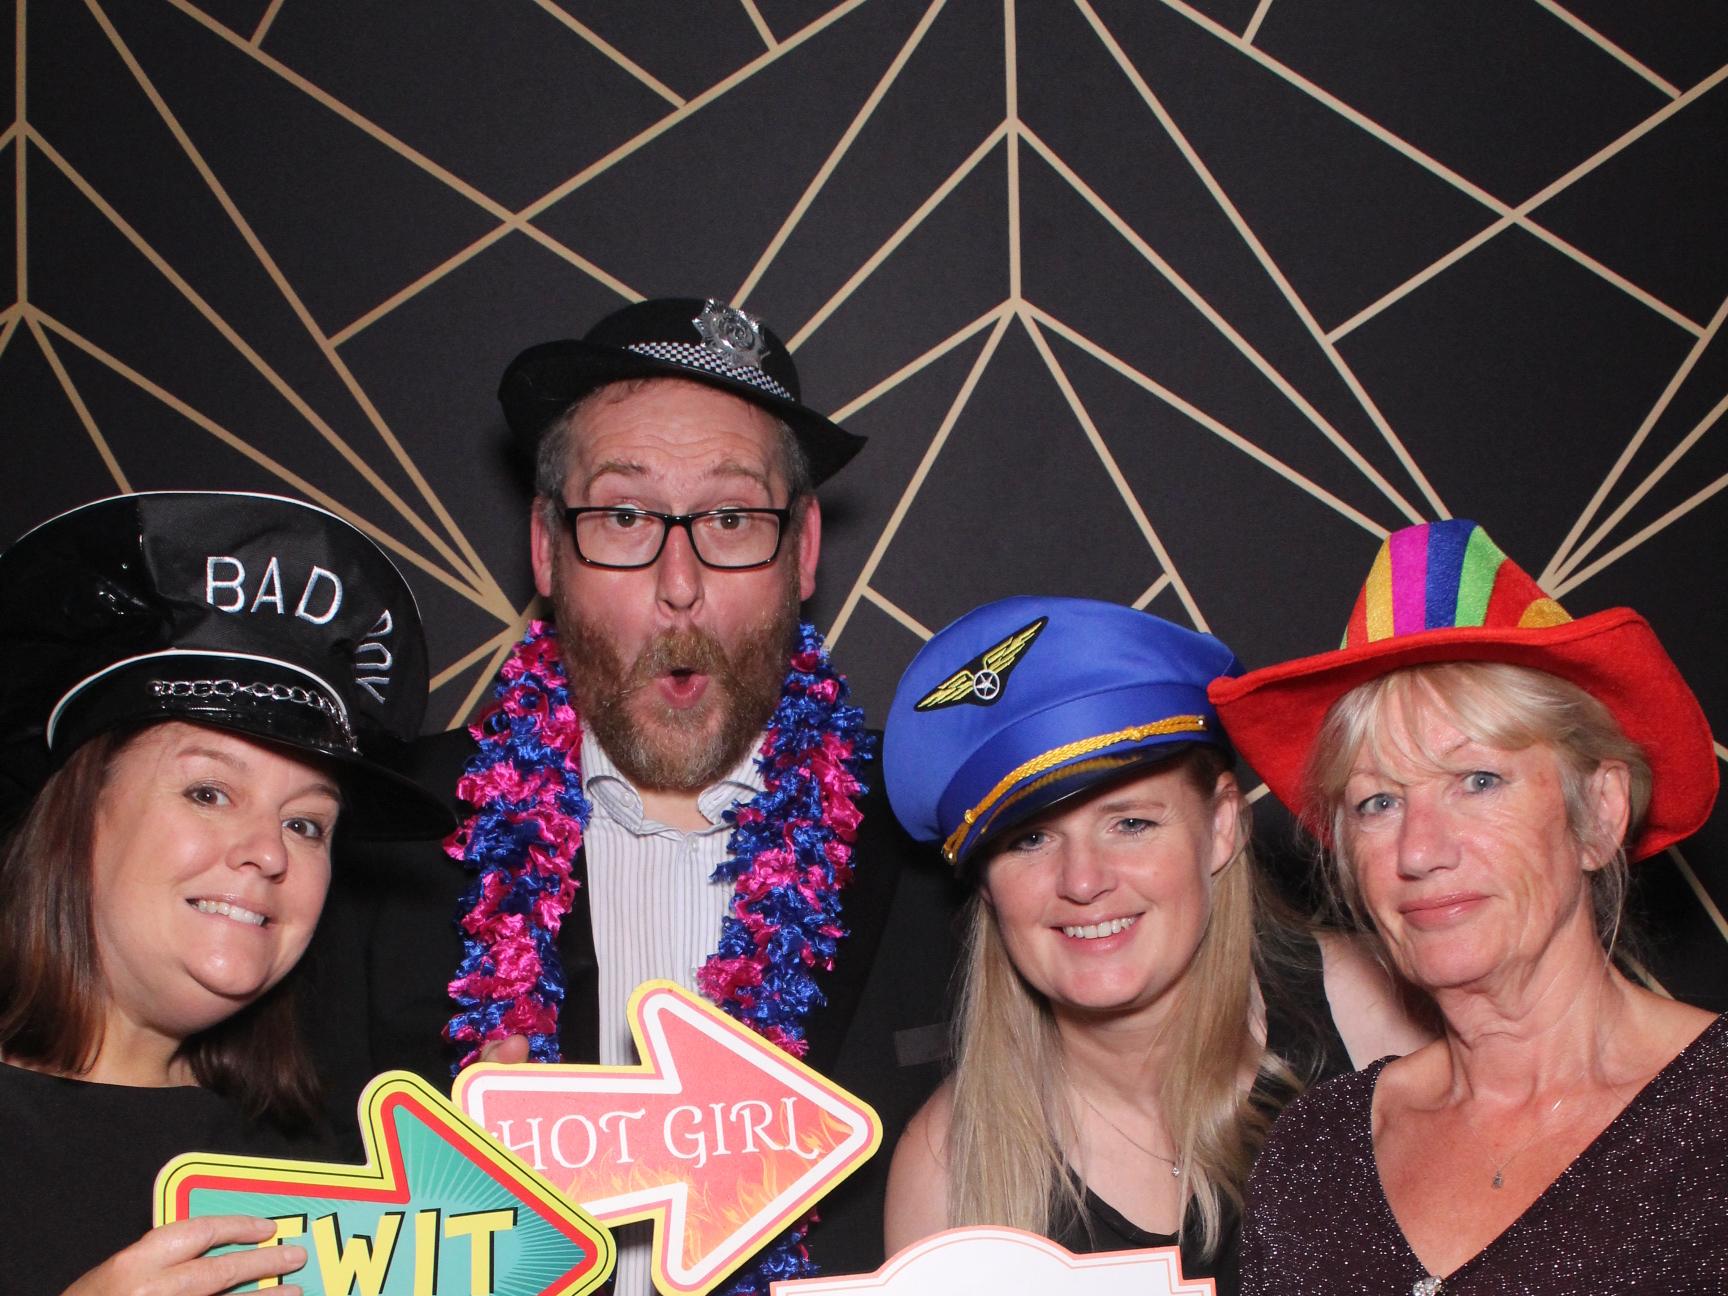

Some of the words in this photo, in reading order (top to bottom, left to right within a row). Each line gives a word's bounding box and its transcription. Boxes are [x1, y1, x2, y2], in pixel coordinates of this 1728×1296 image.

[205, 555, 344, 625] BAD
[491, 1107, 646, 1171] HOT
[663, 1096, 820, 1169] GIRL
